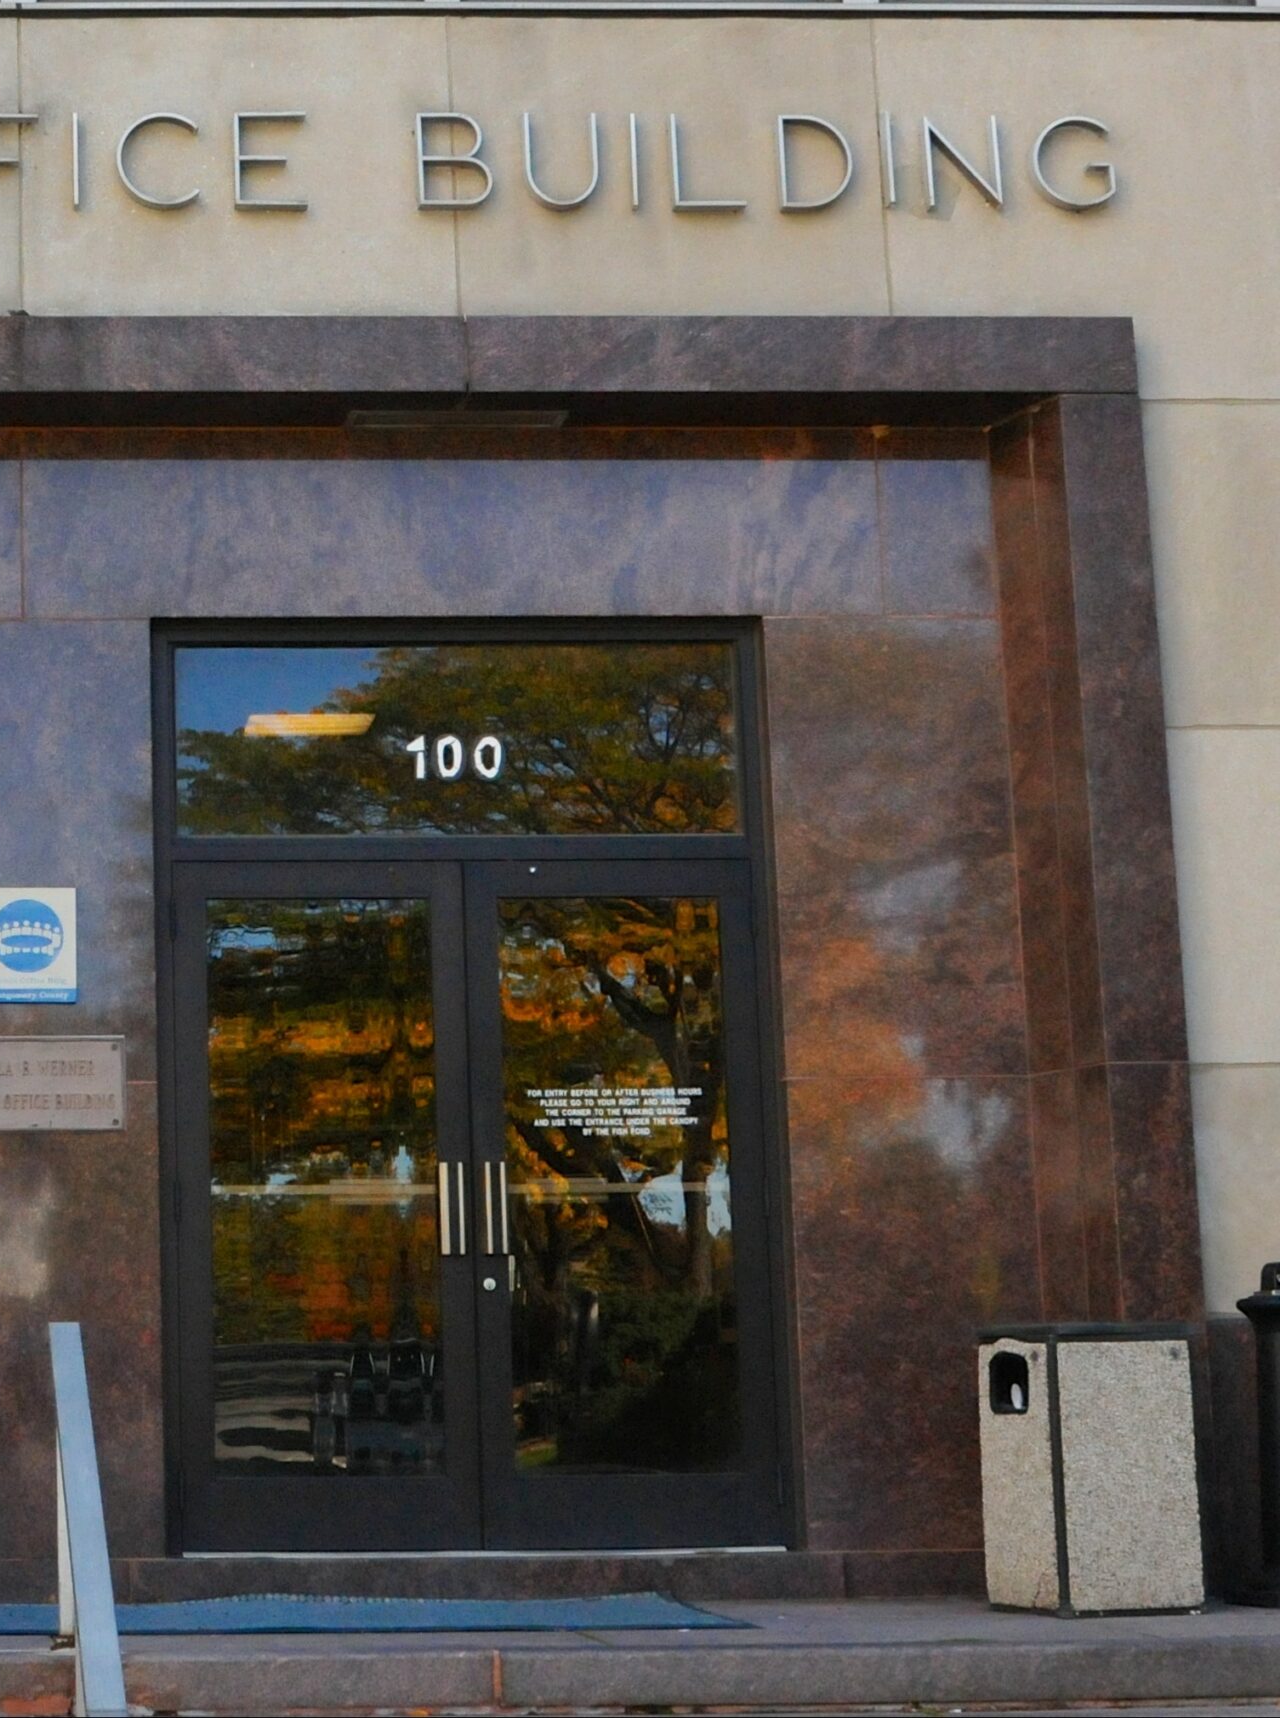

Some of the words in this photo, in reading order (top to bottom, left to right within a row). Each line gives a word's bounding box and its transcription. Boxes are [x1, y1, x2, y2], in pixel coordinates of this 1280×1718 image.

[416, 111, 1117, 212] BUILDING
[406, 735, 502, 779] 100
[39, 991, 69, 1001] County
[37, 1060, 96, 1077] WERNER
[527, 1089, 542, 1097] FOR
[544, 1089, 568, 1097] ENTRY
[570, 1089, 599, 1097] BEFORE
[601, 1088, 612, 1097] OR
[615, 1088, 639, 1096] AFTER
[641, 1088, 675, 1096] BUSINESS
[677, 1087, 702, 1096] HOURS
[2, 1094, 50, 1111] OFFICE
[55, 1094, 116, 1111] BUILDING
[540, 1099, 567, 1107] PLEASE
[597, 1098, 616, 1106] YOUR
[618, 1098, 640, 1106] RIGHT
[643, 1098, 658, 1106] AND
[661, 1098, 691, 1106] AROUND
[545, 1108, 559, 1116] THE
[561, 1108, 591, 1116] CORNER
[594, 1108, 604, 1116] TO
[656, 1107, 686, 1115] GARAGE
[534, 1119, 549, 1127] AND
[568, 1118, 582, 1126] THE
[585, 1118, 623, 1126] ENTRANCE
[626, 1117, 650, 1125] UNDER
[652, 1117, 666, 1125] THE
[669, 1117, 698, 1125] CANOPY
[582, 1128, 592, 1136] BY
[596, 1128, 609, 1136] THE
[612, 1127, 628, 1135] FISH
